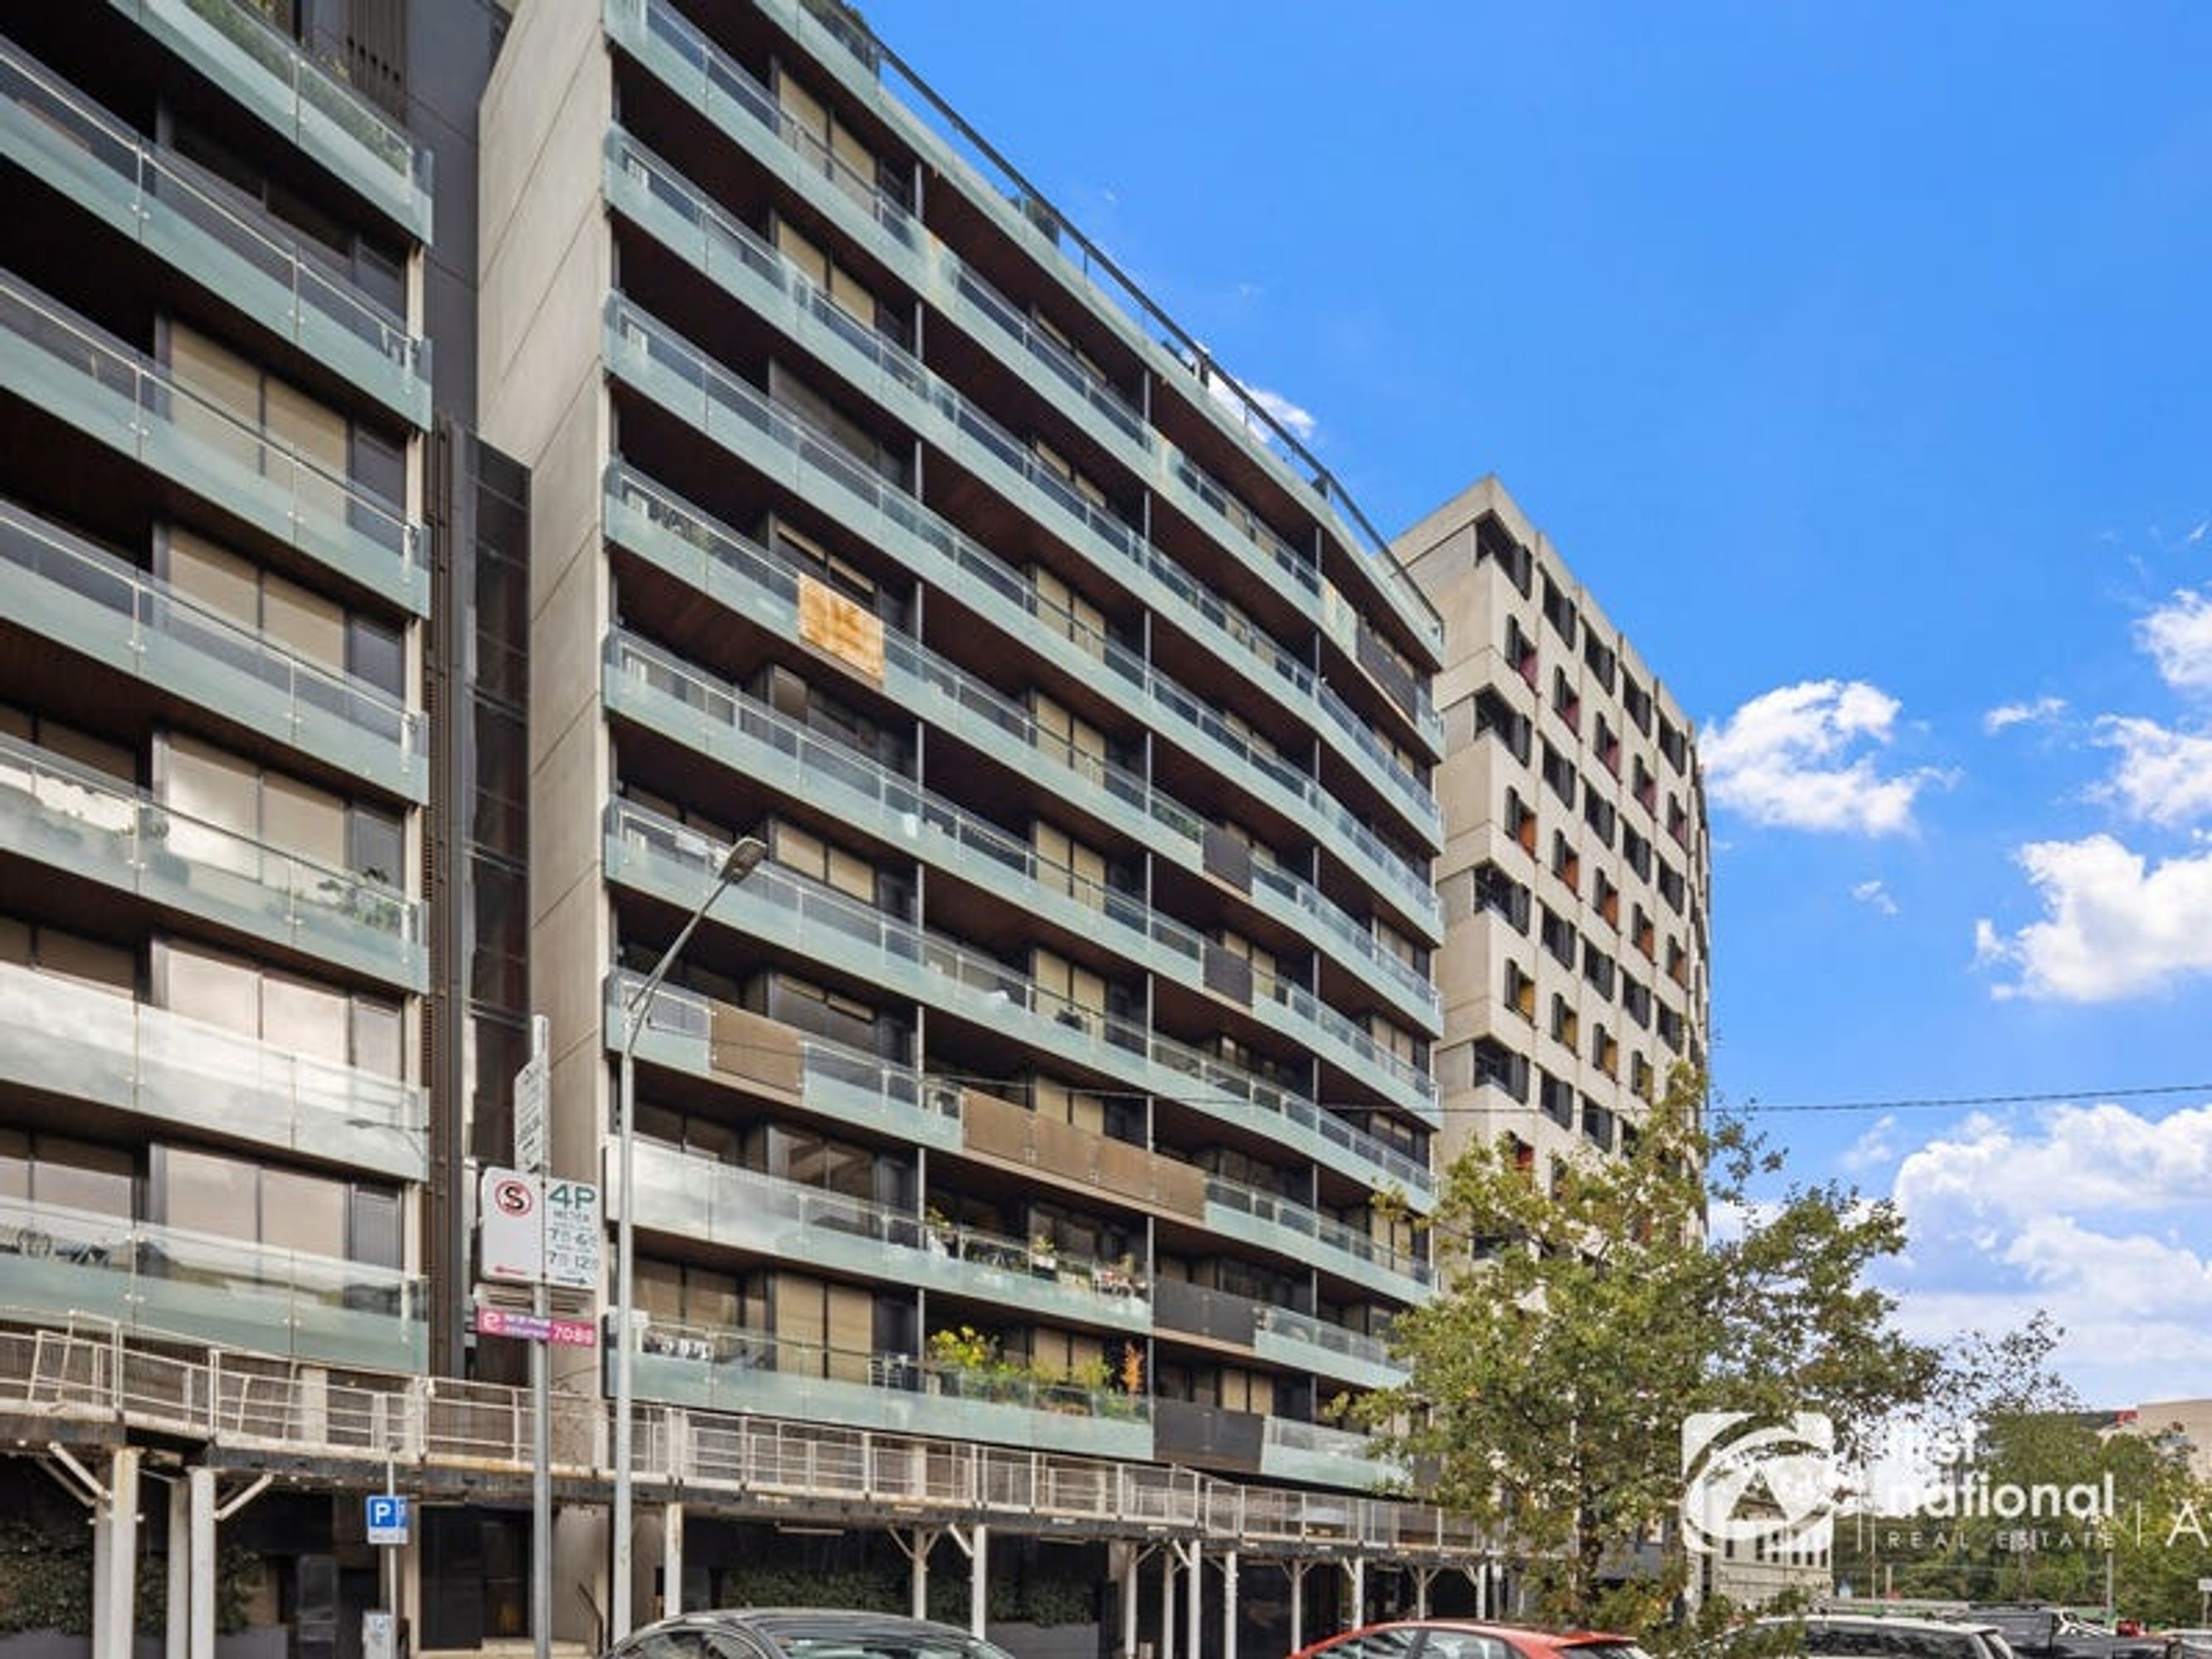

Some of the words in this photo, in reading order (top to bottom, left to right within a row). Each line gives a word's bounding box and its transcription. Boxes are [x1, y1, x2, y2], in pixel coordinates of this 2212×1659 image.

[505, 1186, 524, 1209] S
[548, 1184, 596, 1209] 4P
[376, 1503, 391, 1525] P
